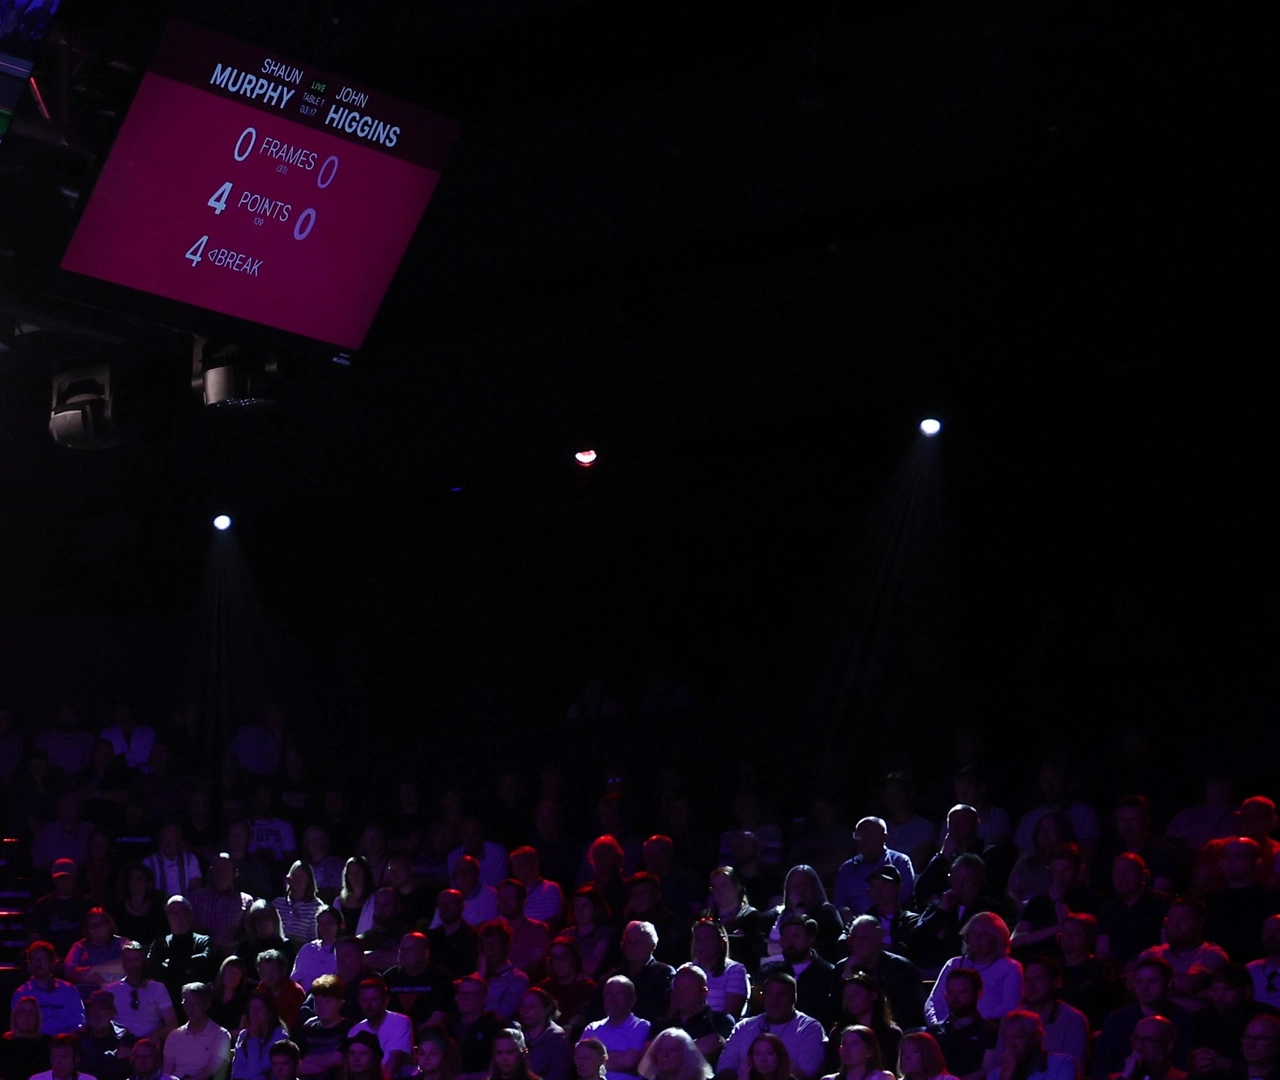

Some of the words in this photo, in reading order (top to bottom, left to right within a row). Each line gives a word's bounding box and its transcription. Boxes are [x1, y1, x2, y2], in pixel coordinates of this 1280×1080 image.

[209, 63, 296, 109] MURPHY
[261, 58, 304, 85] SHAUN
[311, 81, 327, 92] LIVE
[303, 92, 321, 106] TABLE
[335, 86, 369, 108] JOHN
[324, 104, 401, 147] HIGGINS
[234, 127, 257, 162] 0
[259, 137, 318, 171] FRAMES
[317, 155, 339, 189] 0
[207, 181, 233, 215] 4
[238, 191, 292, 222] POINTS
[293, 207, 317, 241] 0
[184, 235, 209, 267] 4
[214, 248, 264, 277] BREAK
